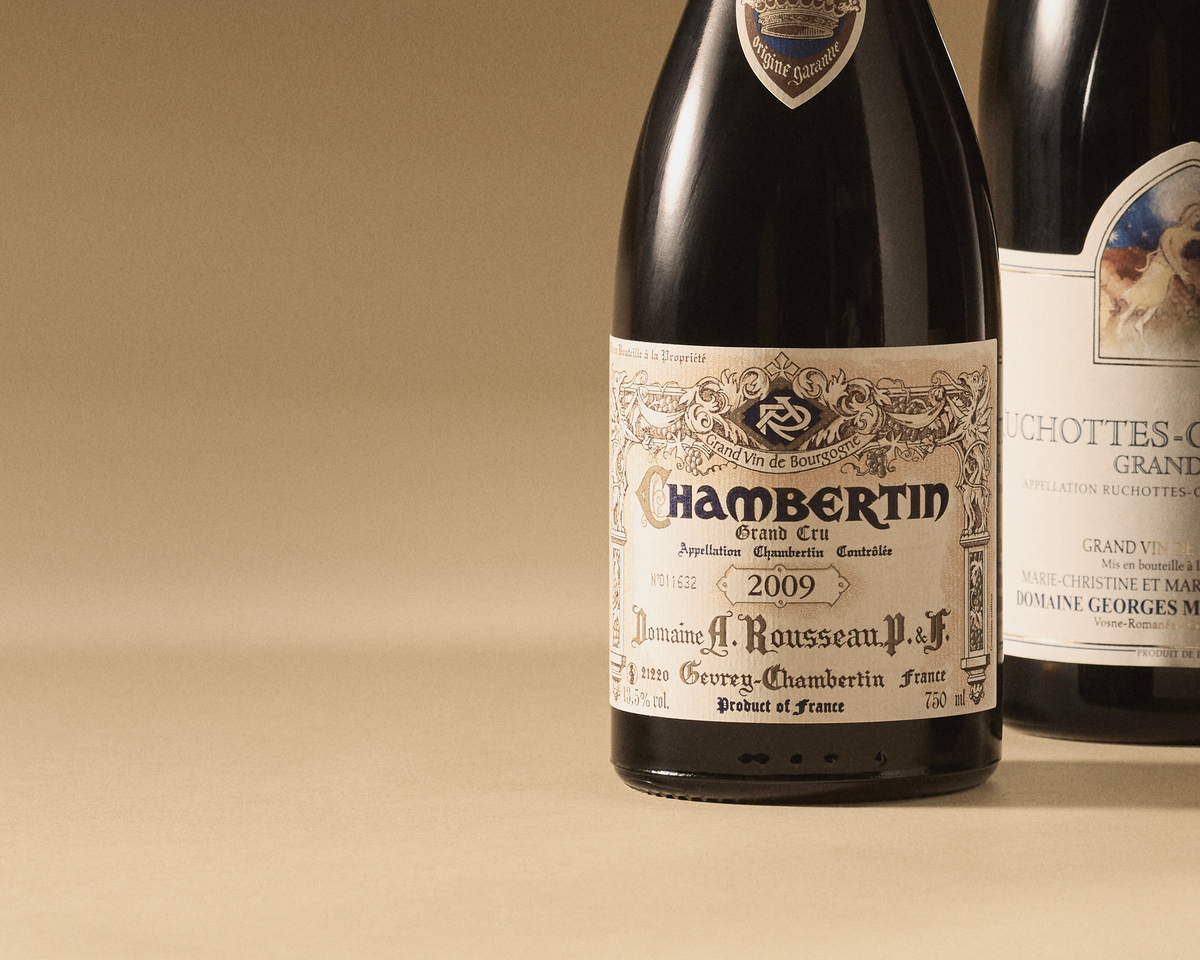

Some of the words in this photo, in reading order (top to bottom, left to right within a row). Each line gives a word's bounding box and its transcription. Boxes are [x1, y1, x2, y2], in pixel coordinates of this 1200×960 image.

[752, 35, 791, 78] origine
[661, 350, 707, 365] Propriété
[706, 434, 744, 461] Grand
[744, 451, 765, 468] Vin
[769, 454, 786, 469] de
[790, 435, 862, 468] Bourgogne
[1023, 478, 1097, 495] APPELLATION
[735, 524, 787, 541] Grand
[796, 524, 829, 541] Cru
[677, 542, 742, 558] Appellation
[753, 545, 824, 560] Chambertin
[836, 544, 893, 558] Contrôlée
[1082, 538, 1136, 555] GRAND
[1140, 541, 1168, 556] VIN
[1101, 559, 1121, 570] Mis
[1123, 561, 1135, 570] en
[1138, 559, 1184, 572] bouteille
[1187, 560, 1193, 572] à
[748, 574, 816, 599] 2009
[1021, 570, 1138, 591] MARIE-CHRISTINE
[1143, 578, 1160, 592] ET
[1016, 590, 1083, 612] DOMAINE
[1088, 597, 1177, 616] GEORGES
[631, 605, 704, 649] Domaine
[737, 614, 883, 656] Rousseau
[1137, 649, 1178, 659] PRODUIT
[1181, 649, 1195, 659] DE
[641, 666, 669, 682] 21220
[679, 659, 885, 697] Gevrey-Chambertin
[899, 669, 946, 688] France
[653, 691, 670, 710] vol.
[716, 697, 770, 714] Product
[776, 699, 791, 714] of
[792, 698, 845, 716] France
[924, 690, 947, 709] 750
[954, 688, 966, 707] ml
